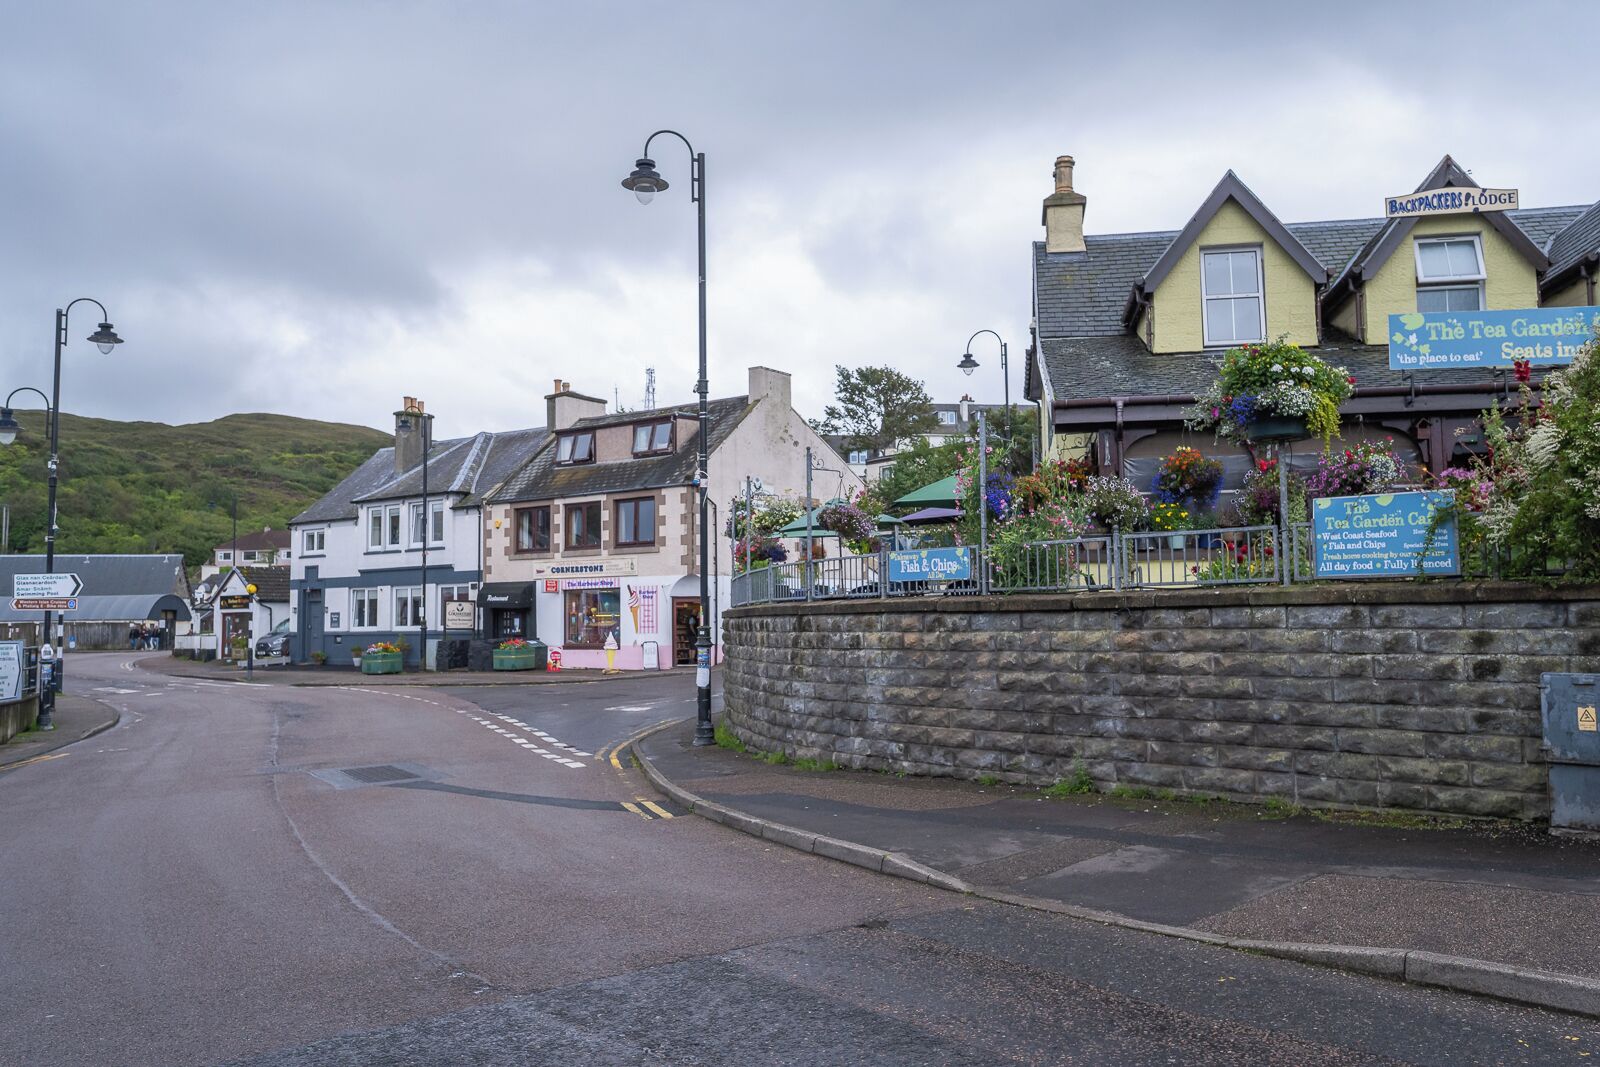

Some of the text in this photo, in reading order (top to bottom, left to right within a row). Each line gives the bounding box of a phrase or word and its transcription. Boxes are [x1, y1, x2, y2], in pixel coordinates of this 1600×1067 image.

[1388, 191, 1516, 215] BACKPACKERS LODGE
[1426, 321, 1465, 340] The
[1469, 320, 1508, 338] Tea
[1511, 317, 1589, 337] Garden
[1501, 341, 1553, 359] Seats
[1419, 352, 1447, 365] place
[1449, 352, 1461, 362] to
[1343, 501, 1370, 515] The
[1325, 516, 1350, 530] Tea
[1353, 513, 1405, 528] Garden
[1322, 529, 1398, 540] West Coast Seafood
[1329, 540, 1386, 550] Fish and Chips
[551, 564, 604, 574] CORNERSTONE
[900, 558, 958, 573] Fish & Chips
[1320, 558, 1452, 572] All day food Fully lienced
[927, 571, 945, 579] All Day
[600, 579, 614, 587] Shop
